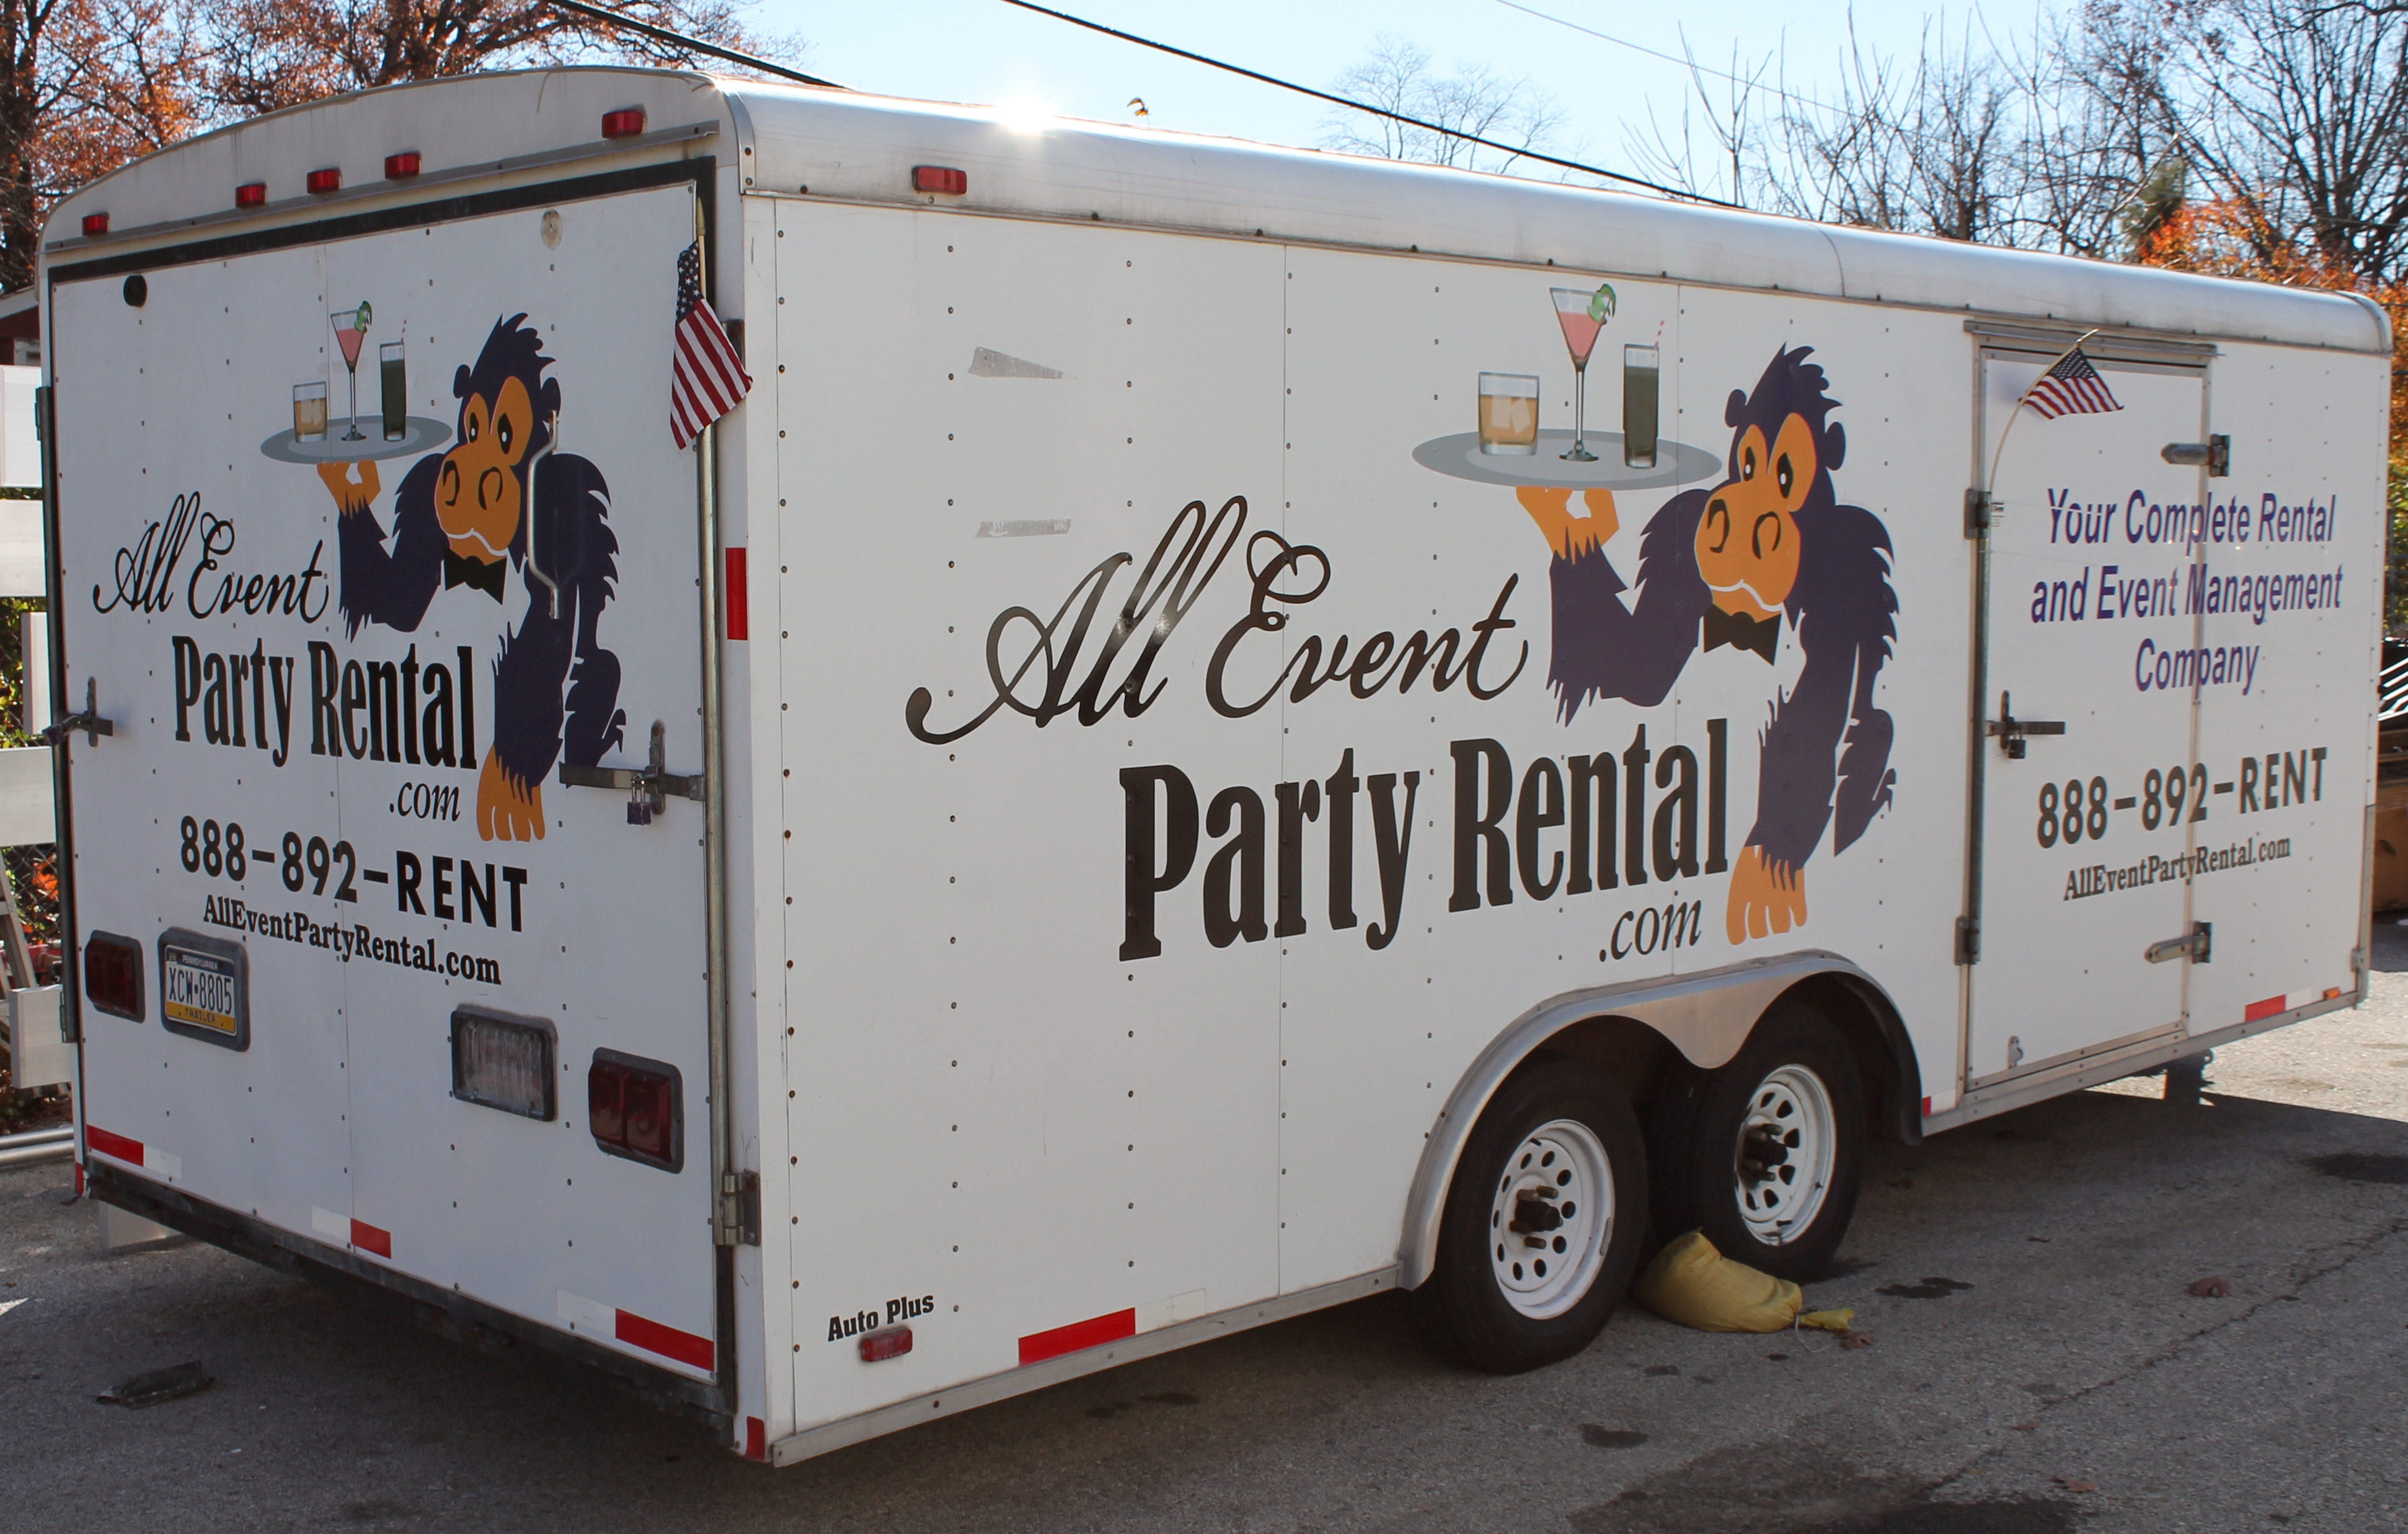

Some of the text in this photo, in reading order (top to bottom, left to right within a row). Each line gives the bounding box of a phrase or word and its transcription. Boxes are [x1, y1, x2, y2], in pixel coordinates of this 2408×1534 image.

[2048, 488, 2117, 544] Your
[2126, 489, 2251, 558] Complete
[2259, 493, 2337, 542] Rental
[92, 491, 329, 624] All Event
[905, 495, 1529, 744] All Event
[2030, 563, 2344, 625] and Event Management
[2136, 638, 2260, 699] Company
[172, 635, 477, 770] Party Rental
[389, 782, 461, 821] .com
[1119, 718, 1728, 961] Party Rental
[2063, 836, 2291, 902] AllEventPartyRental.com
[182, 954, 218, 971] PENNSYLVANIA
[203, 894, 502, 986] AllEventPartyRental.com
[1599, 900, 1702, 962] .com
[185, 1008, 216, 1023] TRAILER
[828, 1295, 934, 1342] Auto Plus
